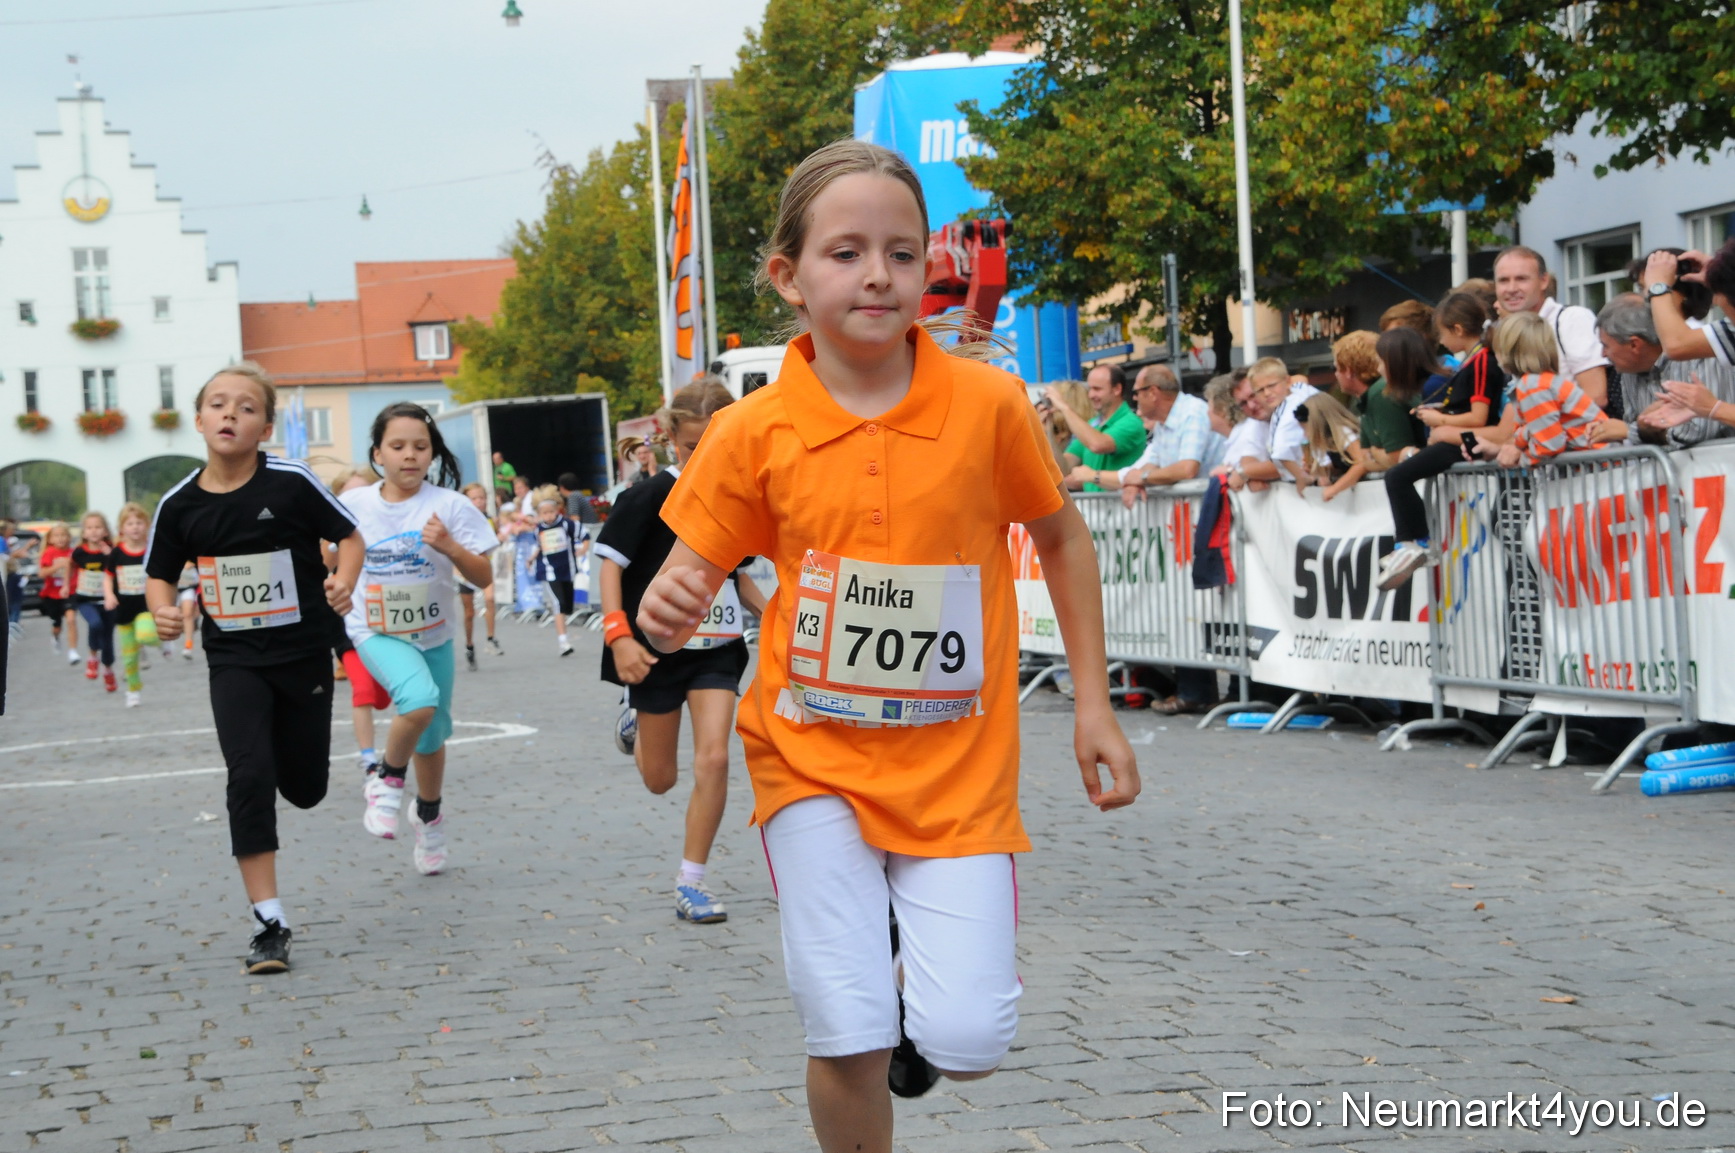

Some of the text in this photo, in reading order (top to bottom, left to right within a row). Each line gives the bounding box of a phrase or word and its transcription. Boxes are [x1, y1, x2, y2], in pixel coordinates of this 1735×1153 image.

[221, 563, 251, 577] Anna
[226, 580, 285, 606] 7021
[386, 590, 411, 602] Julia
[845, 573, 914, 609] Anika
[389, 603, 440, 625] 7016
[797, 612, 820, 637] K3
[845, 624, 966, 674] 7079
[1288, 631, 1362, 664] stadtwerke
[804, 691, 853, 710] BOCK
[905, 698, 972, 713] PFLEIDERER
